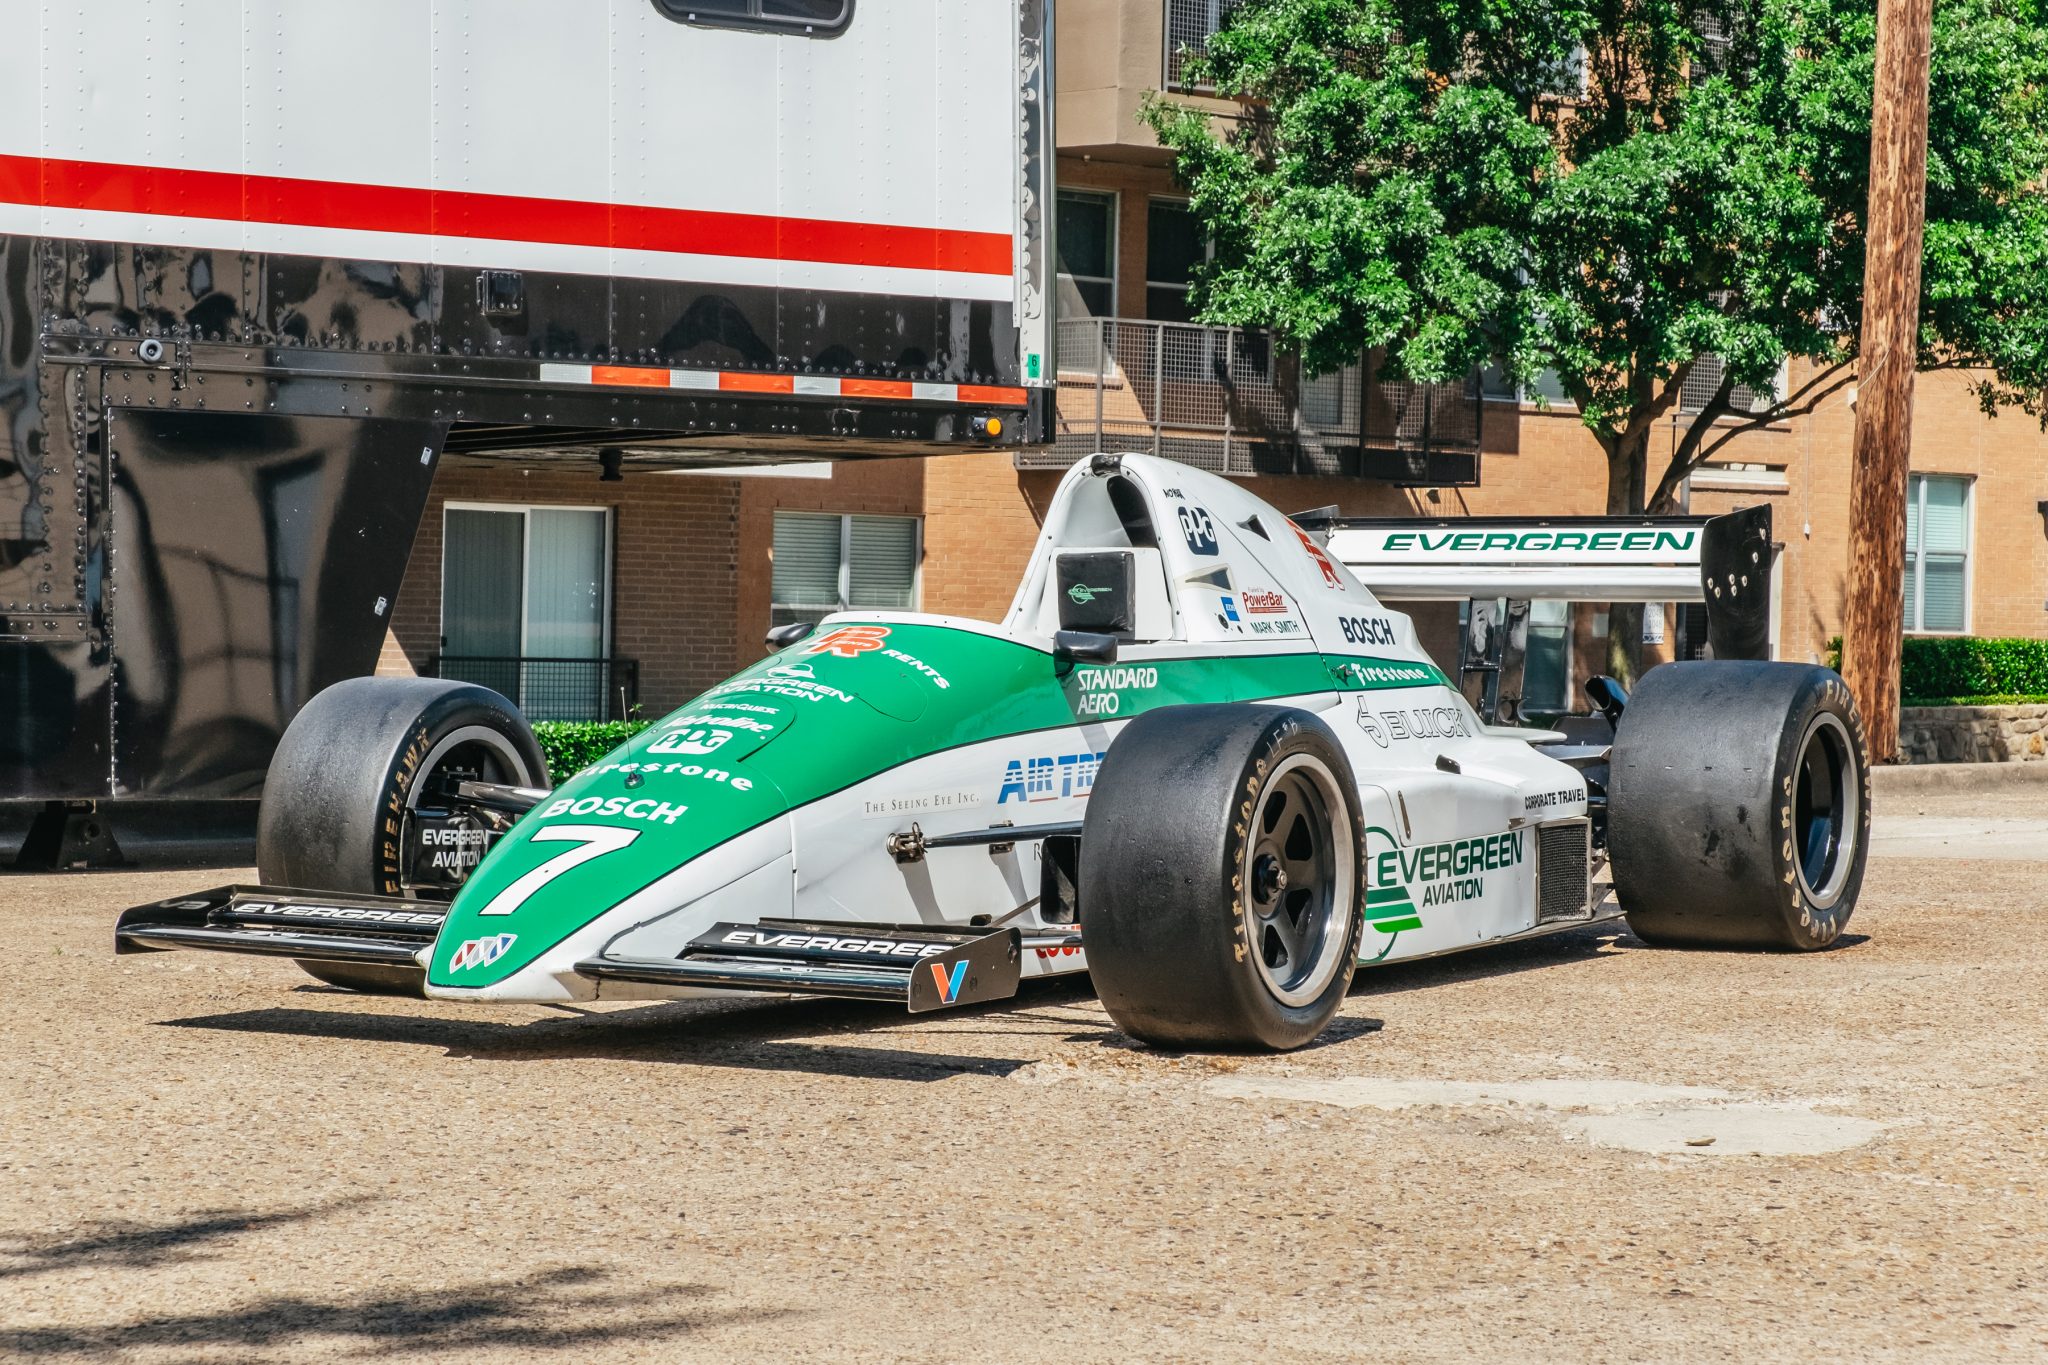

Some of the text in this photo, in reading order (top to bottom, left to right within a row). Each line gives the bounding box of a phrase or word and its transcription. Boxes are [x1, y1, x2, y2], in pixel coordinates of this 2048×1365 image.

[1179, 507, 1218, 551] PPG
[1381, 531, 1695, 551] EVERGREEN
[1242, 592, 1284, 613] PowerBar
[1250, 620, 1300, 634] MARK SMITH
[1338, 616, 1396, 645] BOSCH
[881, 649, 950, 689] RENTS
[1077, 667, 1158, 691] STANDARD
[1350, 662, 1429, 686] Firestone
[1077, 692, 1119, 715] AERO
[1379, 707, 1472, 740] BUICK
[650, 728, 732, 753] PPG
[540, 796, 689, 825] BOSCH
[1525, 788, 1586, 810] CORPORATE TRAVEL
[422, 828, 488, 845] EVERGREEN
[432, 851, 481, 868] AVIATION
[477, 823, 643, 917] 7
[1377, 830, 1524, 888] EVERGREEN
[1422, 877, 1483, 907] AVIATION
